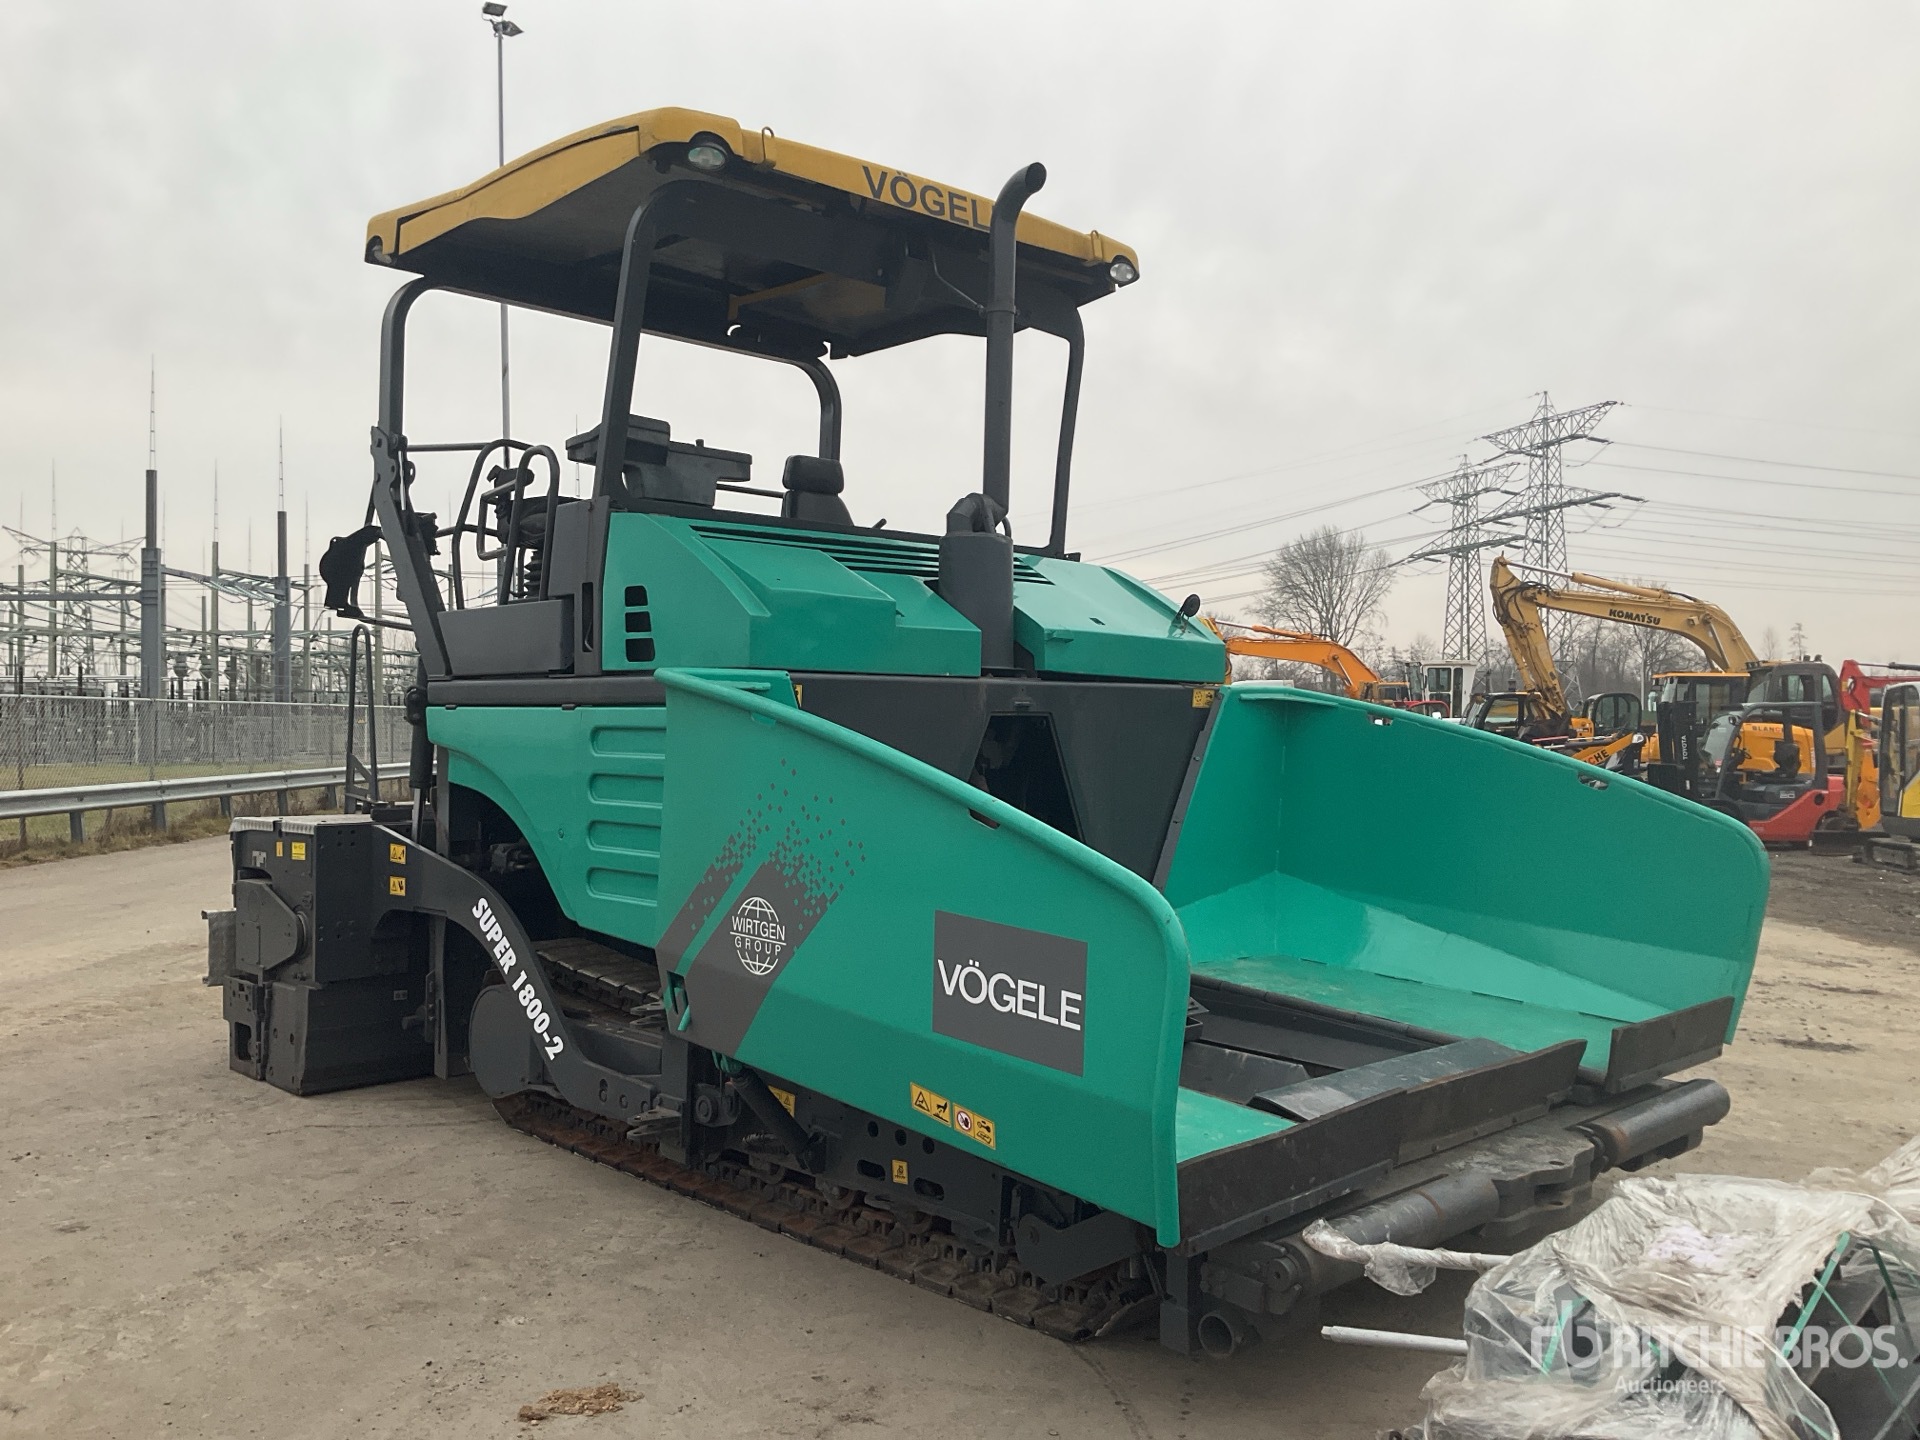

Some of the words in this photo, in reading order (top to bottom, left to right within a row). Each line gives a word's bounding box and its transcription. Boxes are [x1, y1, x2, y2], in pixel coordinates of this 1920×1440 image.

[1609, 609, 1661, 626] KOMATSU
[732, 915, 785, 941] WIRTGEN
[735, 936, 782, 956] GROUP
[472, 897, 517, 974] SUPER
[511, 969, 564, 1061] 1800-2
[937, 958, 1082, 1031] VÖGELE
